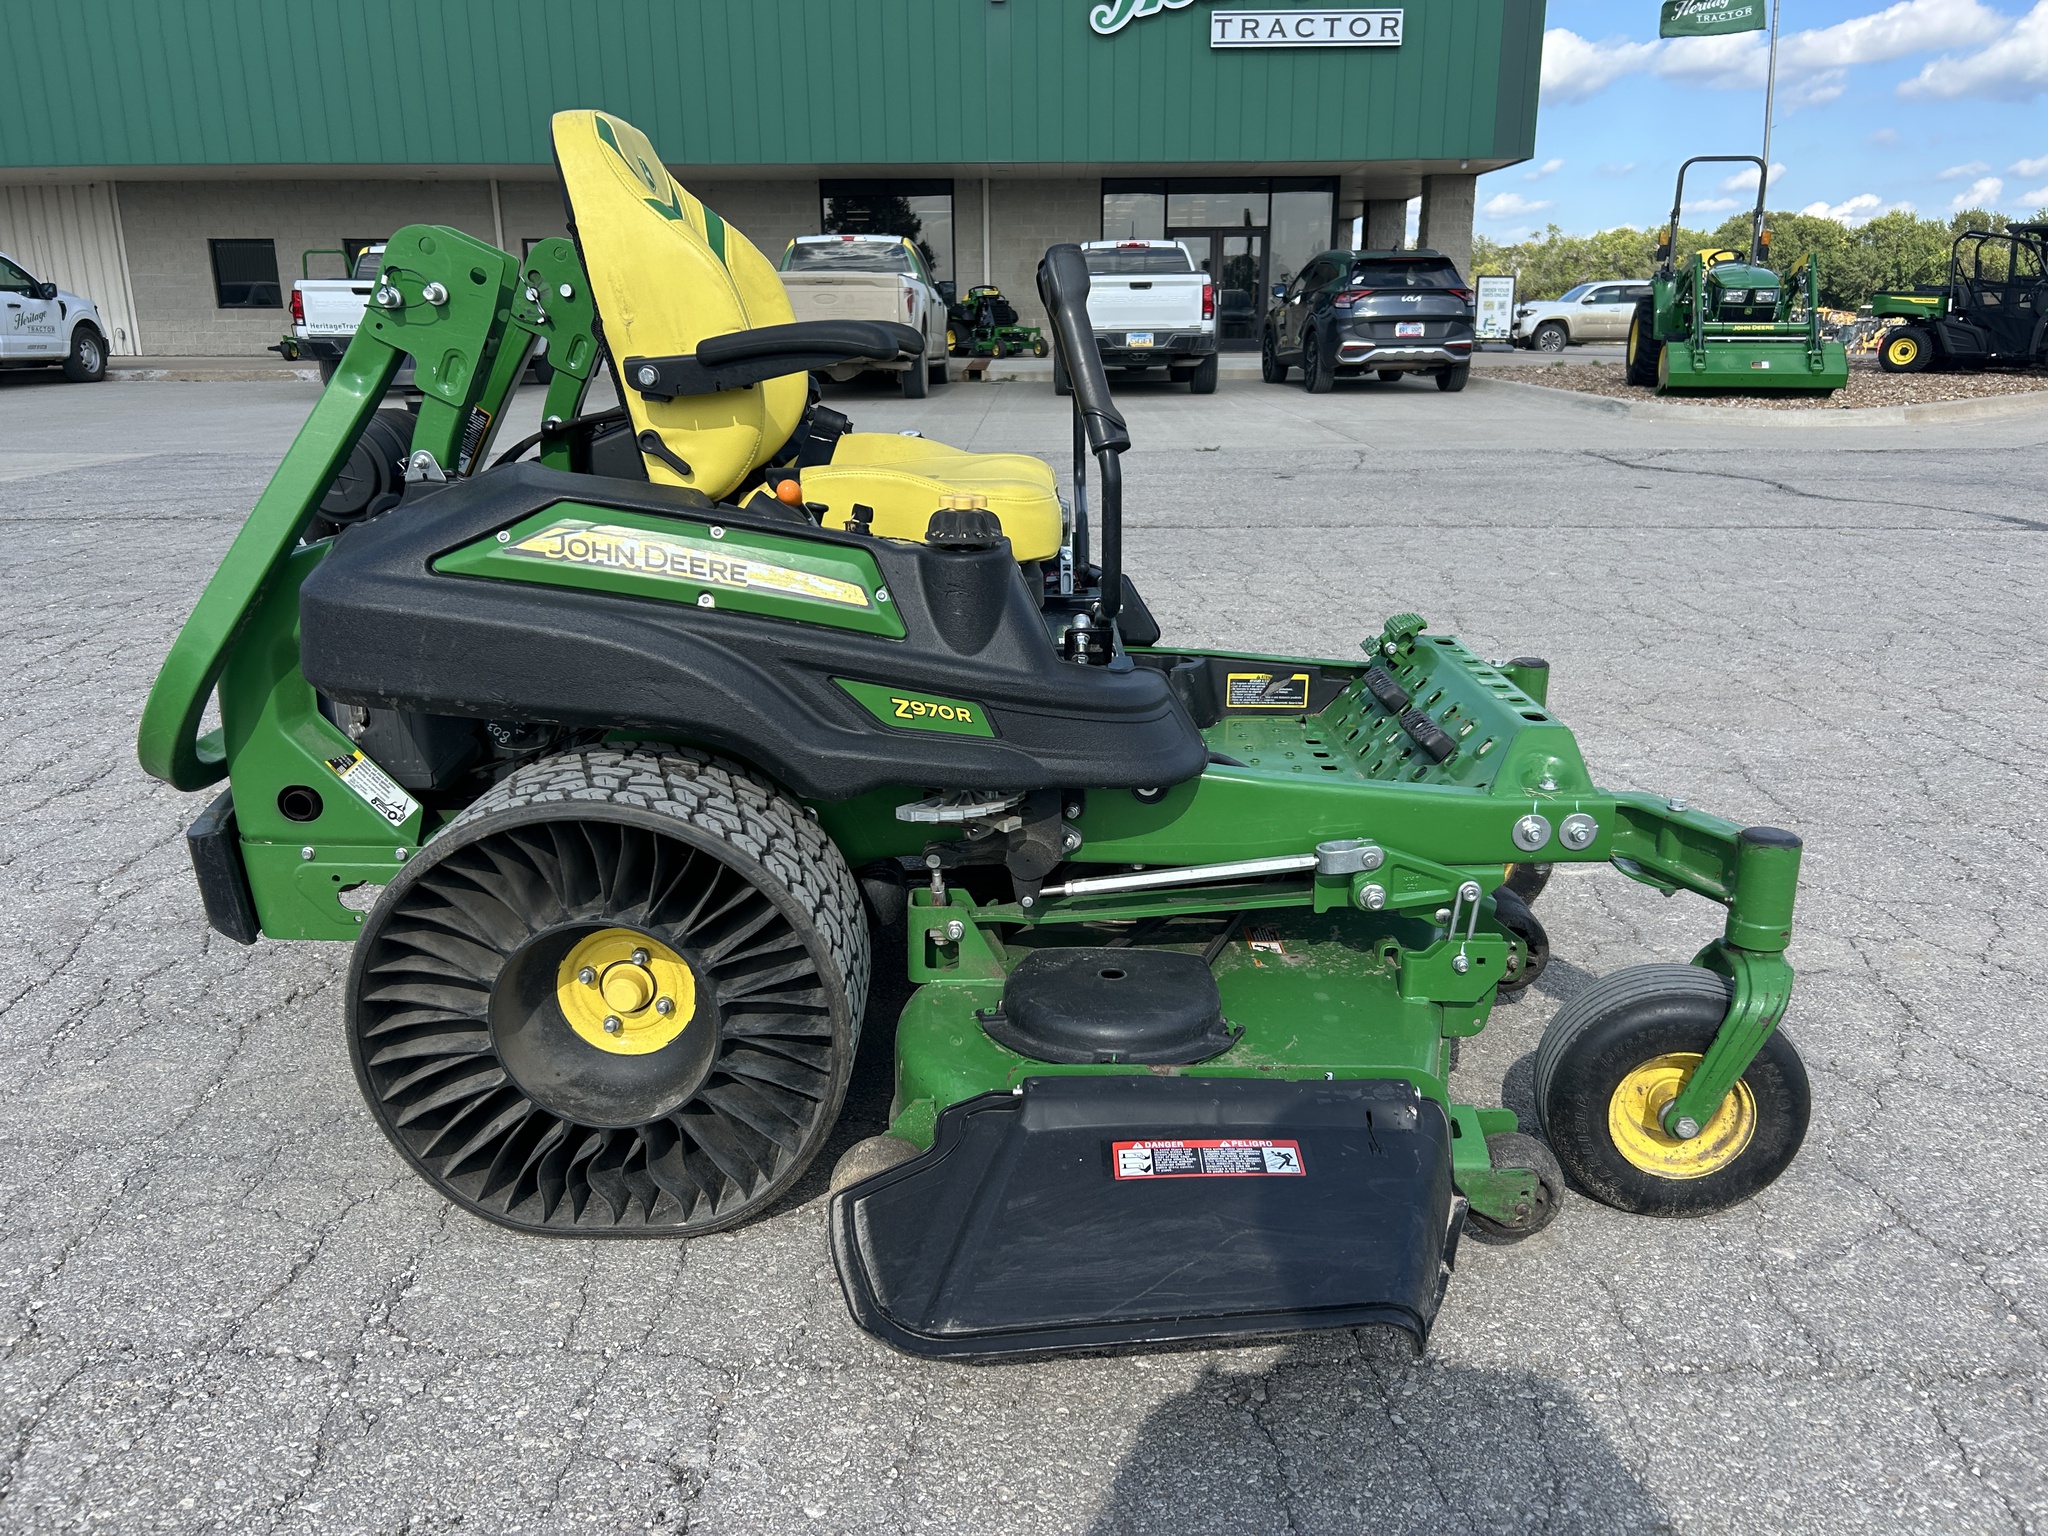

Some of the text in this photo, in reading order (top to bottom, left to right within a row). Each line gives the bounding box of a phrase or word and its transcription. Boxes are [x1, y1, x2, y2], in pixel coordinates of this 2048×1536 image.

[1696, 7, 1752, 22] TRACTOR
[1214, 17, 1400, 39] TRACTOR
[14, 311, 47, 330] Heritage
[27, 325, 56, 333] TRACTOR
[548, 535, 748, 584] JOHN DEERE
[890, 697, 974, 724] Z970R
